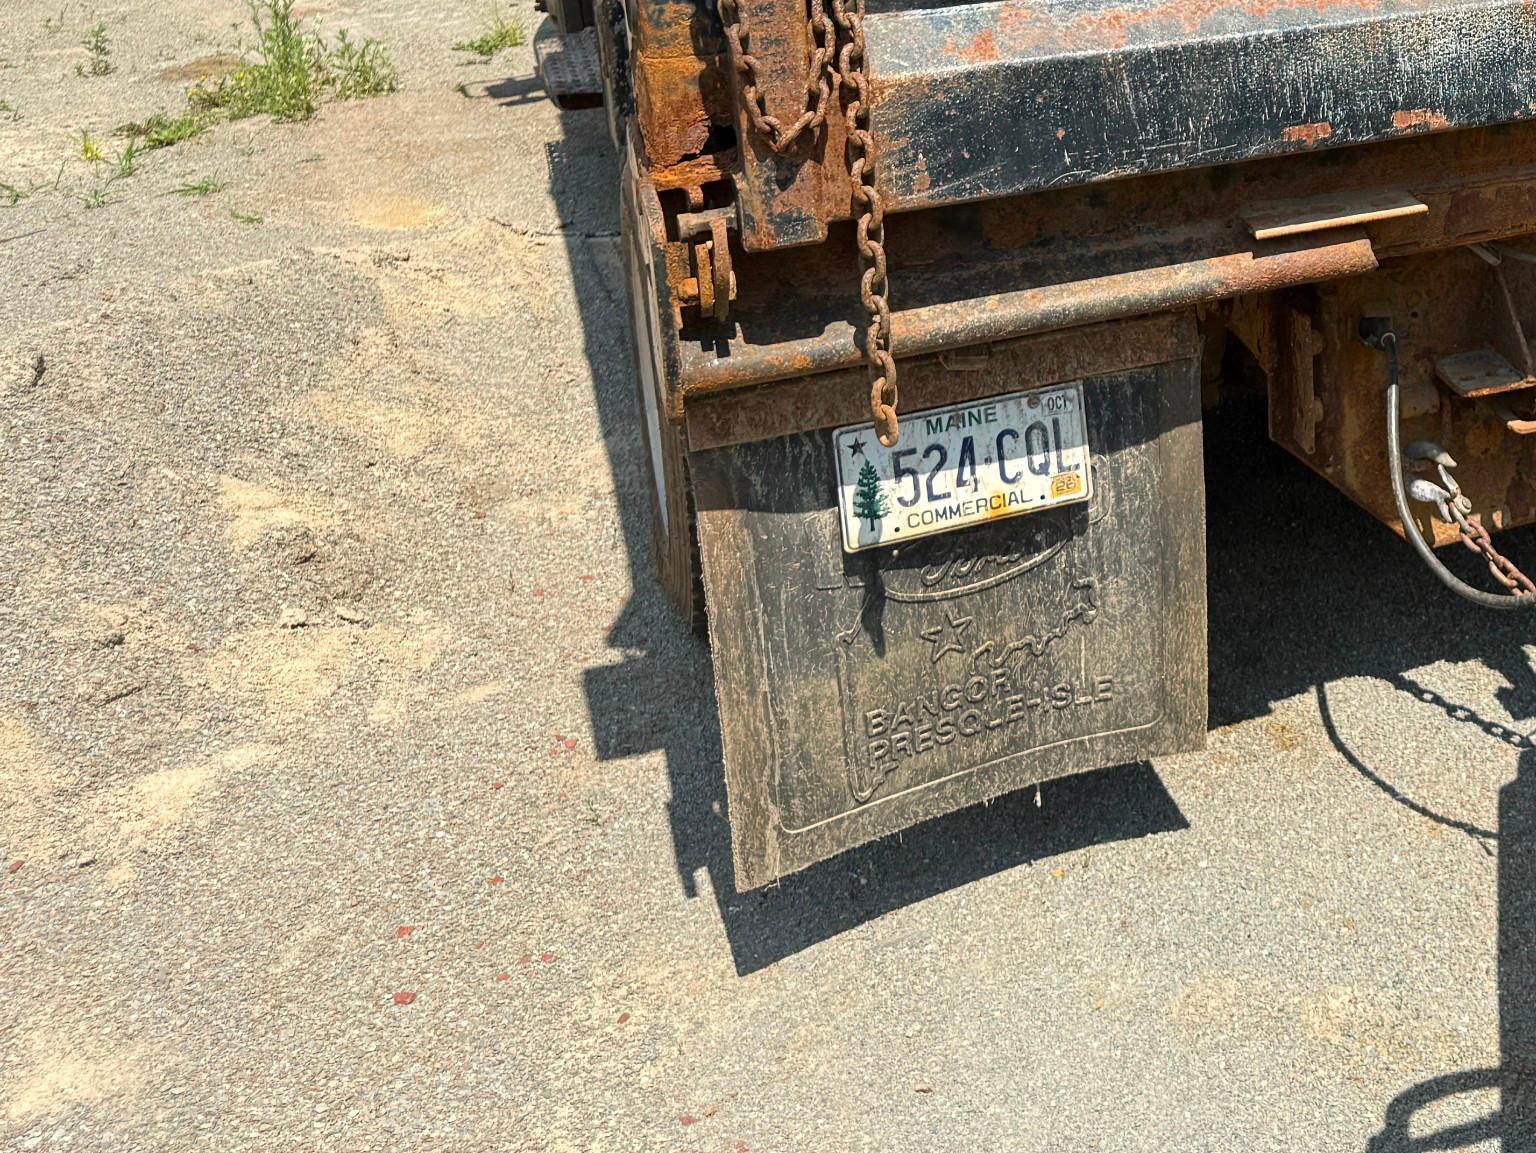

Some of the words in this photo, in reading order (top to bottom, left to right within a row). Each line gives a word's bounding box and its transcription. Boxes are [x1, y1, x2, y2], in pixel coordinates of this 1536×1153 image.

[926, 405, 998, 436] MAINE
[892, 435, 979, 508] 524
[995, 416, 1081, 485] CQL
[907, 488, 1033, 529] COMMERCIAL
[865, 667, 1012, 739] BANGOR
